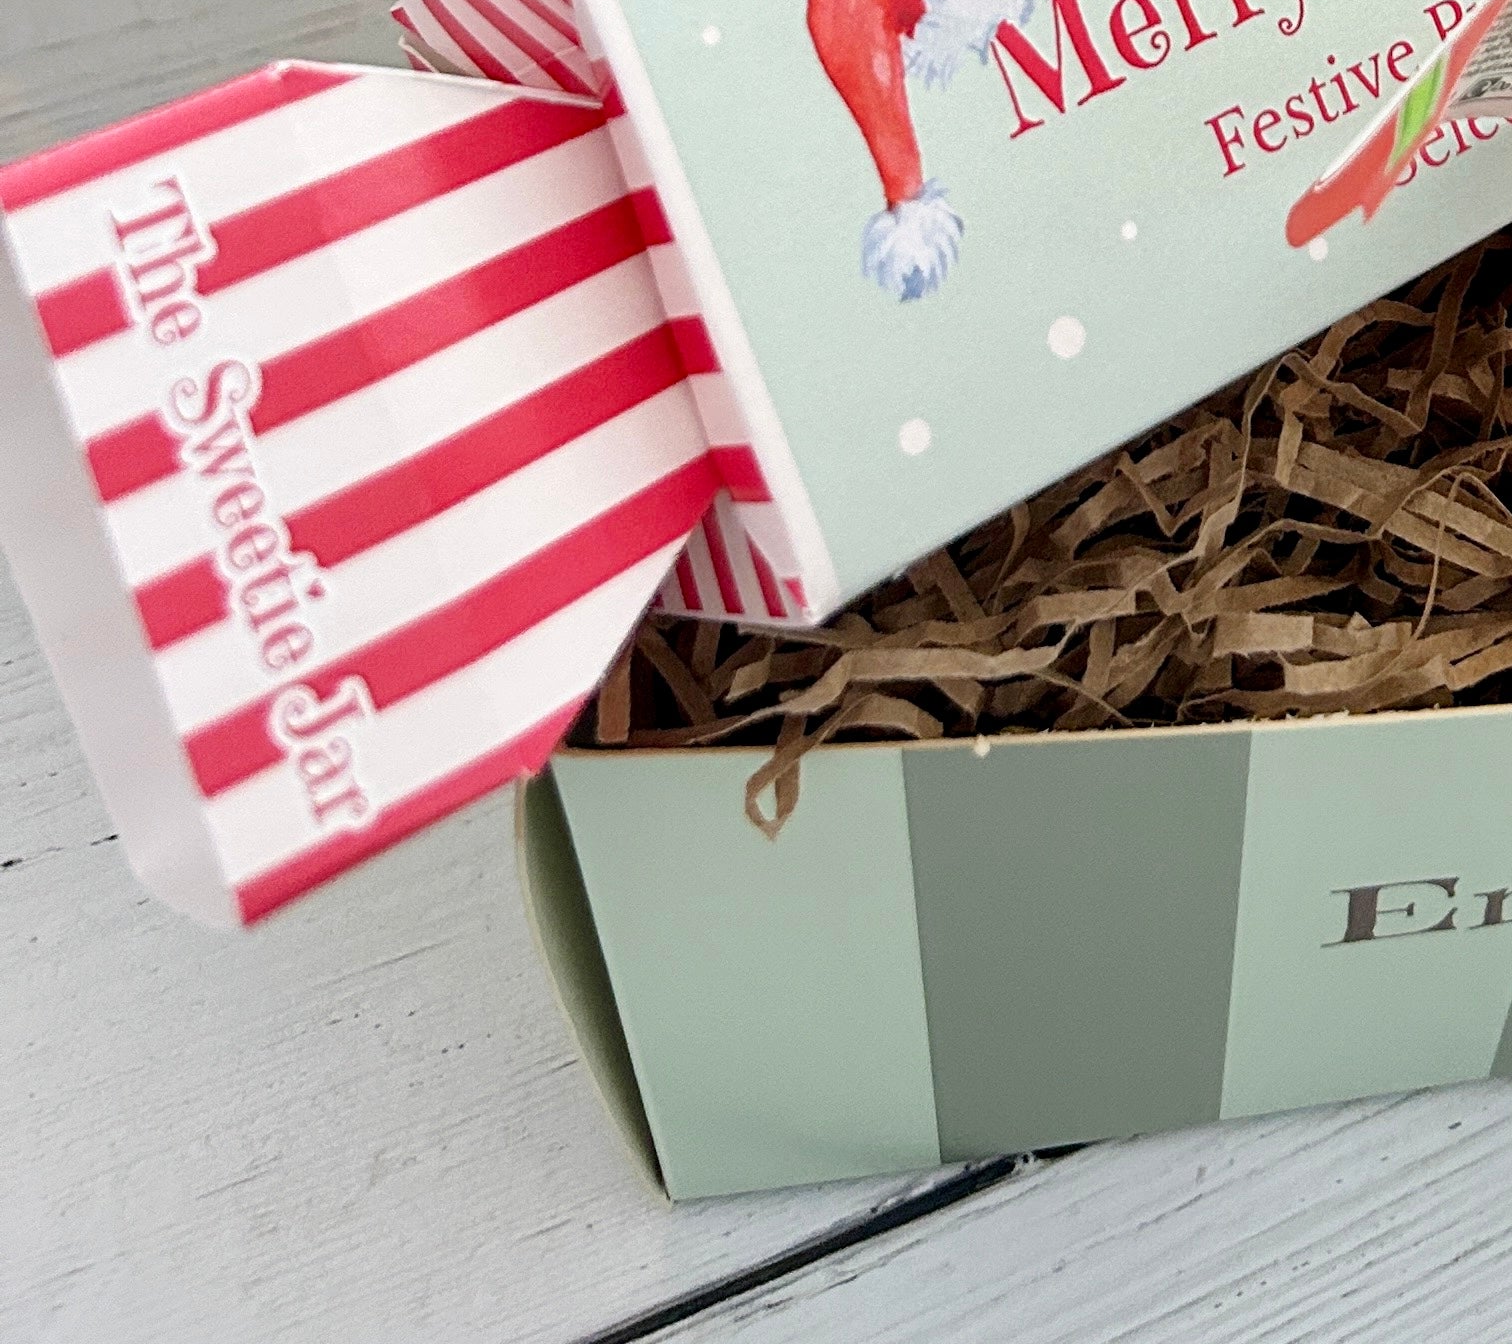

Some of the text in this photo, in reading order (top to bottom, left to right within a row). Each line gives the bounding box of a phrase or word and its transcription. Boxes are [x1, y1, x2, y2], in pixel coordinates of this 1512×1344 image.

[1204, 40, 1415, 178] Festive
[105, 173, 371, 825] The Sweetie Jar
